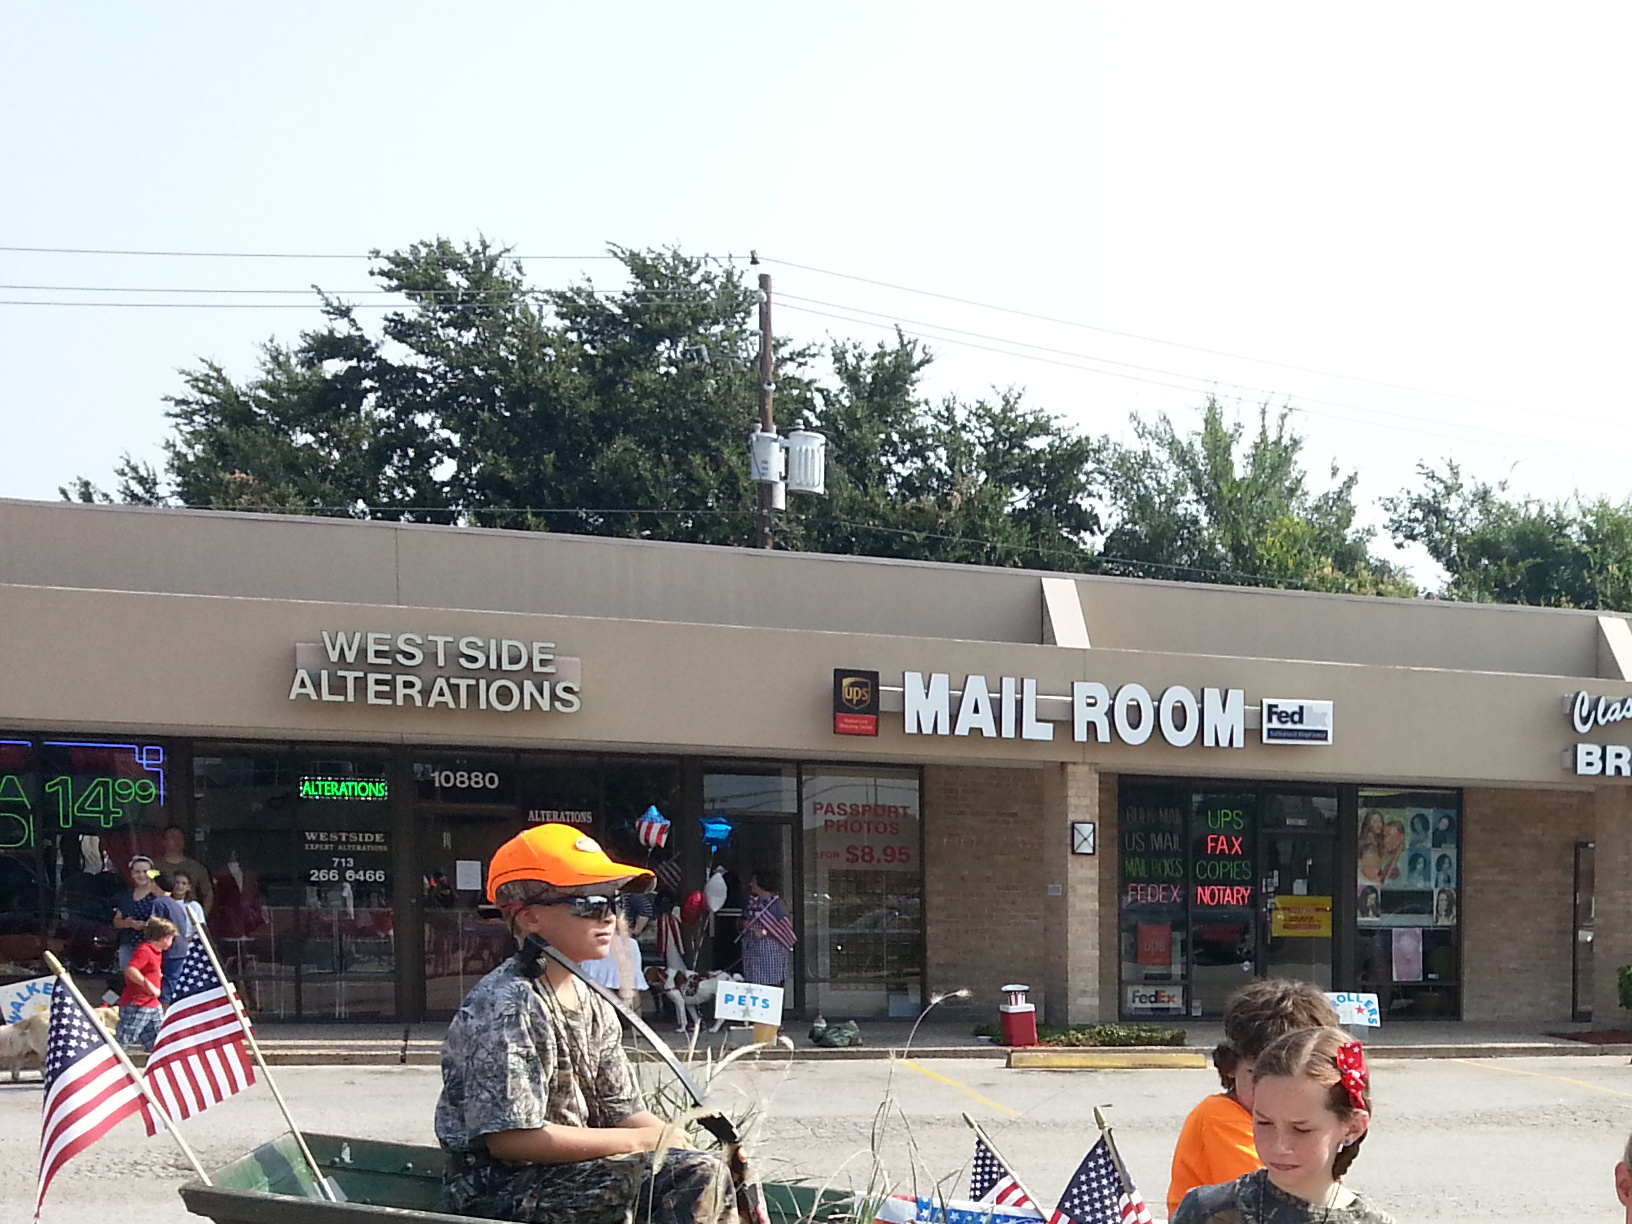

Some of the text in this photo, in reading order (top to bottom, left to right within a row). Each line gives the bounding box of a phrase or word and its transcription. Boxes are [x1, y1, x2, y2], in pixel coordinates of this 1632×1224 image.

[321, 630, 557, 673] WESTSIDE
[289, 668, 581, 713] ALTERATIONS
[844, 686, 869, 705] ups
[902, 670, 1245, 748] MAIL ROOM
[302, 780, 386, 797] ALTERATIONS
[431, 770, 500, 789] 10880
[528, 809, 593, 824] ALTERATIONS
[812, 801, 911, 818] PASSPORT
[824, 819, 900, 835] PHOTOS
[1207, 809, 1244, 830] UPS
[304, 832, 385, 843] WESTSIDE
[1125, 832, 1183, 852] US MAIL
[1206, 834, 1243, 855] FAX
[332, 857, 354, 867] 713
[845, 844, 912, 864] $8.95
[309, 869, 386, 882] 266 6466
[1196, 860, 1252, 880] COPIES
[1127, 883, 1181, 904] FEDEX
[1196, 885, 1252, 906] NOTARY
[724, 993, 770, 1009] PETS
[1132, 989, 1176, 1004] FedEx
